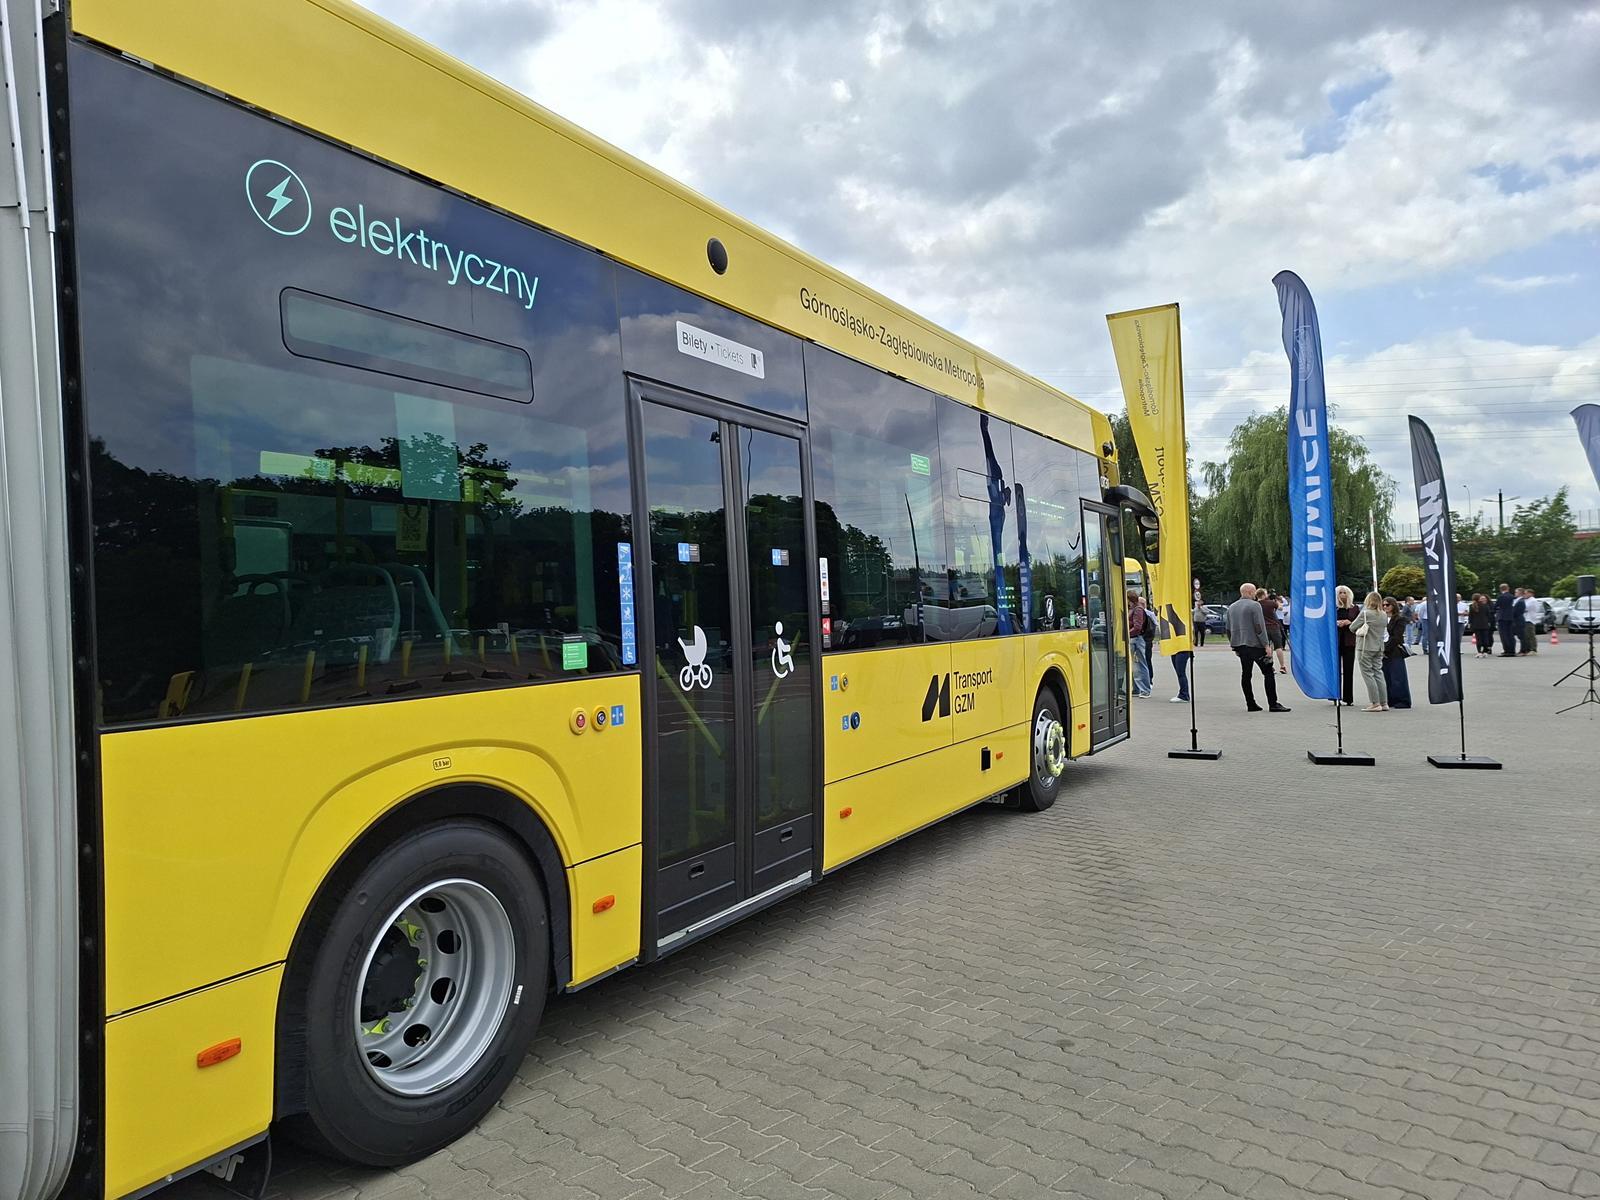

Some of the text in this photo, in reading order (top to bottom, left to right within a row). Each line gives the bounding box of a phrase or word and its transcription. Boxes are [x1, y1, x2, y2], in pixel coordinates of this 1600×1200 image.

[329, 203, 539, 310] elektryczny
[799, 287, 943, 371] Górnośląsko-Zagłębiowska
[681, 330, 745, 366] Bilety Tickets
[953, 667, 993, 690] Transport
[954, 692, 975, 714] GZM
